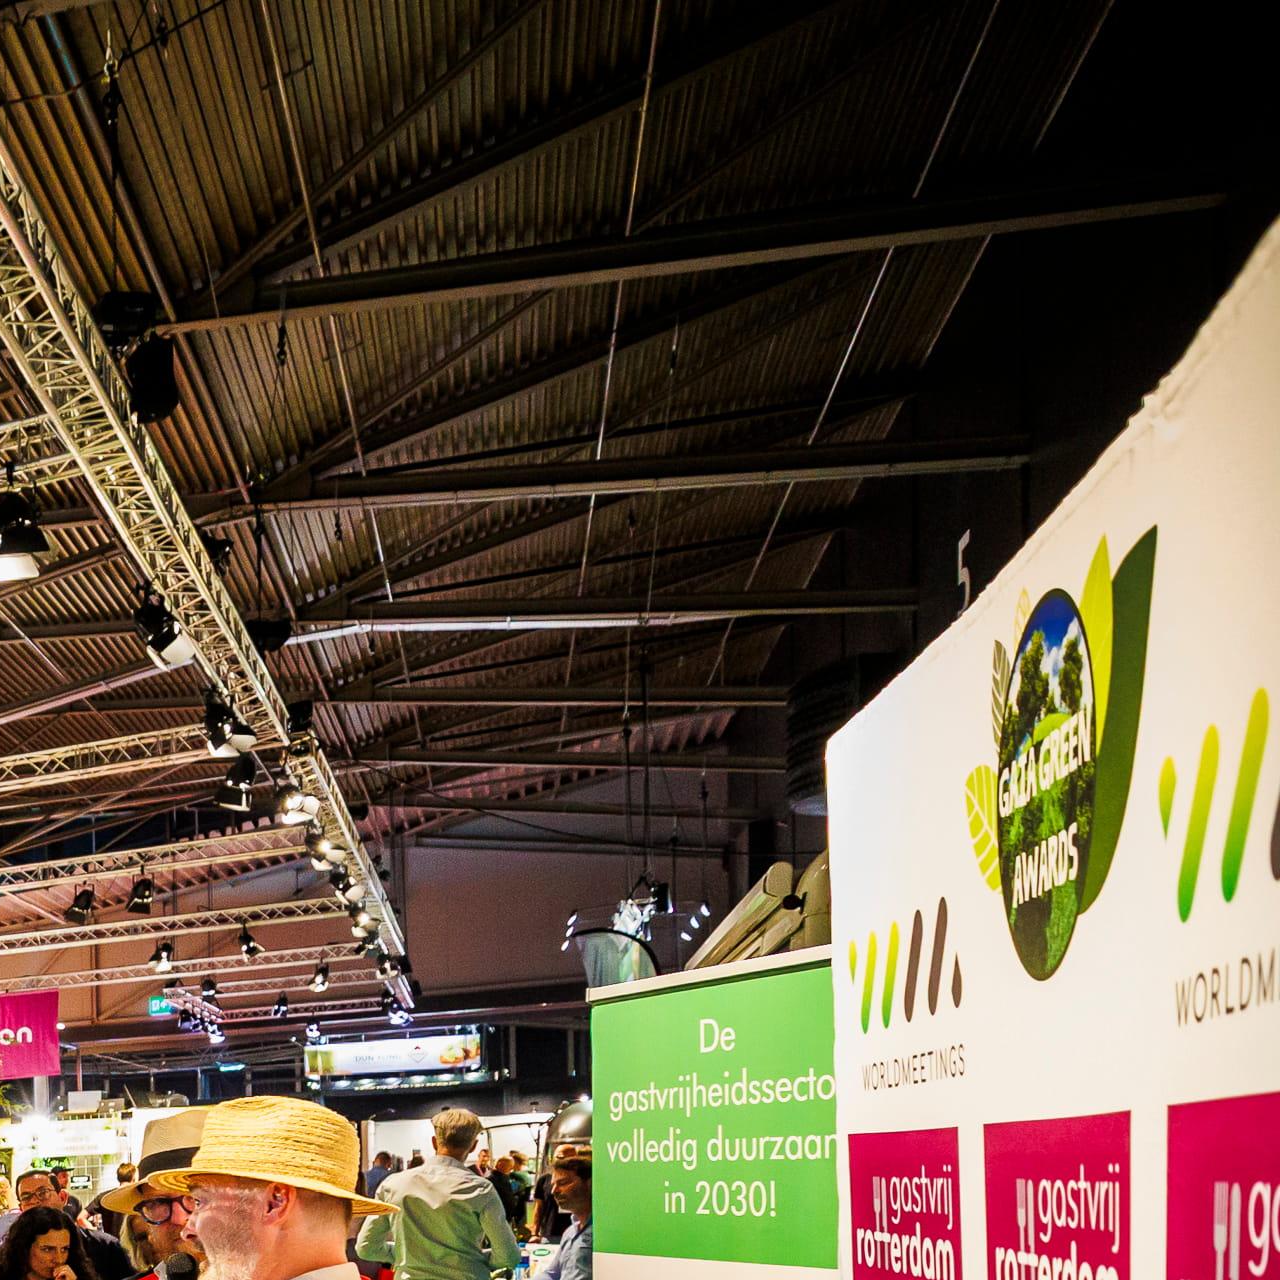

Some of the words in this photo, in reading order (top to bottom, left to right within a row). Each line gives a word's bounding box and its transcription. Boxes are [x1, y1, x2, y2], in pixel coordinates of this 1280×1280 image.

[1039, 704, 1091, 792] GREEN
[1013, 822, 1079, 908] AWARDS
[1175, 947, 1280, 1028] WORLDM
[699, 1018, 736, 1054] De
[861, 1043, 966, 1092] WORLDMEETINGS
[607, 1126, 698, 1171] volledig
[664, 1180, 686, 1214] in
[695, 1180, 777, 1218] 2030!
[889, 1165, 953, 1230] gastvrij
[1038, 1164, 1121, 1253] gastvrij
